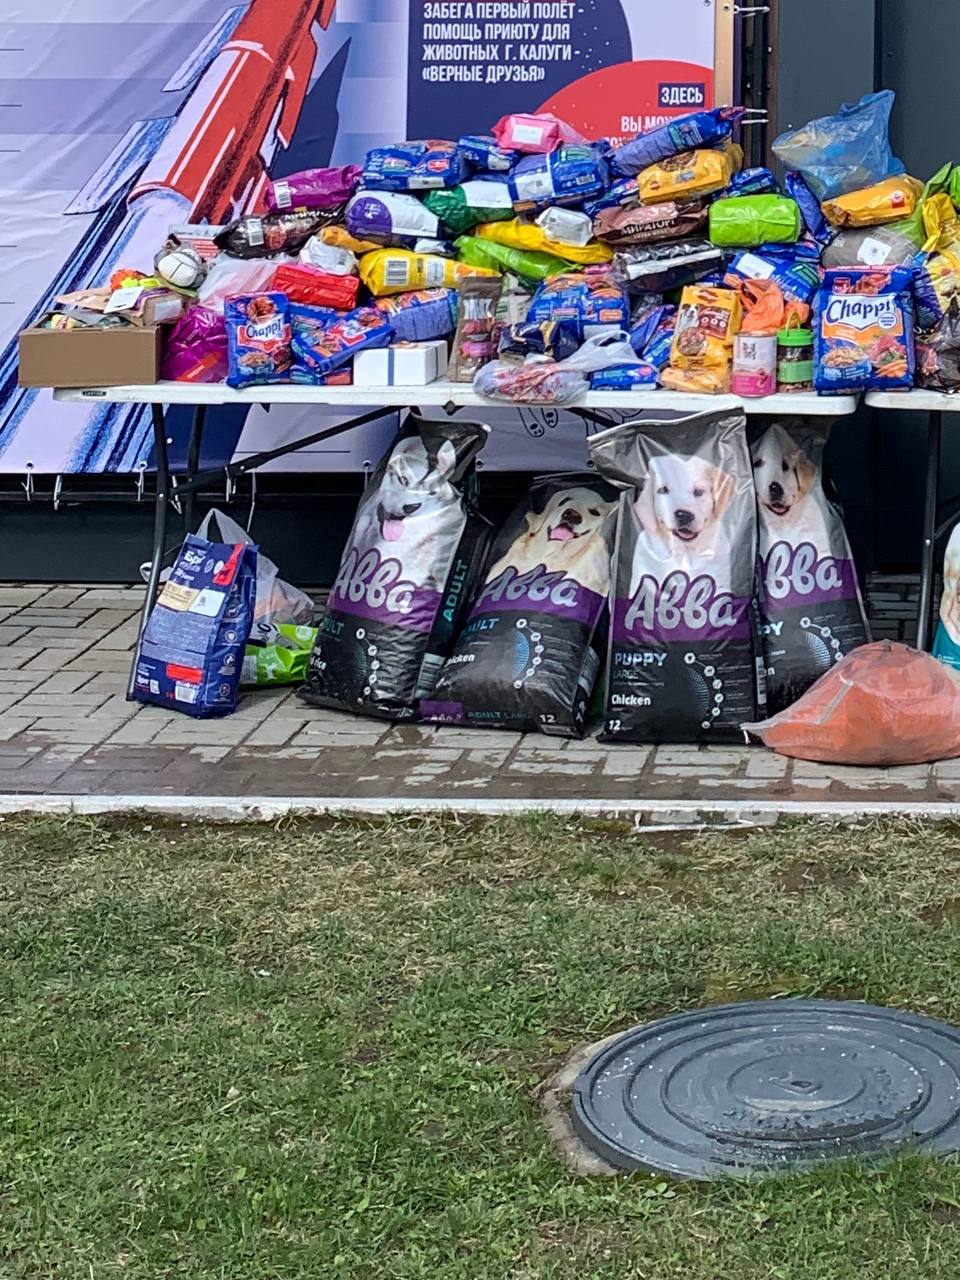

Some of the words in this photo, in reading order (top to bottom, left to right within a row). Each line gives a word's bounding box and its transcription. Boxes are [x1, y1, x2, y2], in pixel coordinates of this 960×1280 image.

[423, 2, 474, 19] ЗАБЕГА
[476, 0, 530, 19] ПЕРВЫЙ
[533, 0, 576, 19] ПОЛЁТ
[423, 23, 482, 41] ПОМОЩЬ
[485, 23, 539, 40] ПРИЮТУ
[541, 23, 570, 41] ДЛЯ
[422, 44, 499, 61] ЖИВОТНЫХ
[505, 44, 517, 61] Г.
[519, 44, 572, 61] КАЛУГИ
[422, 65, 484, 81] «ВЕРНЫЕ
[485, 65, 545, 83] ДРУЗЬЯ»
[661, 86, 704, 104] ЗДЕСЬ
[621, 116, 642, 132] ВЫ
[826, 299, 891, 325] Chappi
[766, 542, 842, 599] bba
[442, 559, 468, 622] ADULT
[614, 652, 668, 667] PUPPY
[611, 693, 652, 706] Chicken
[539, 713, 556, 724] 12
[609, 719, 622, 731] 12
